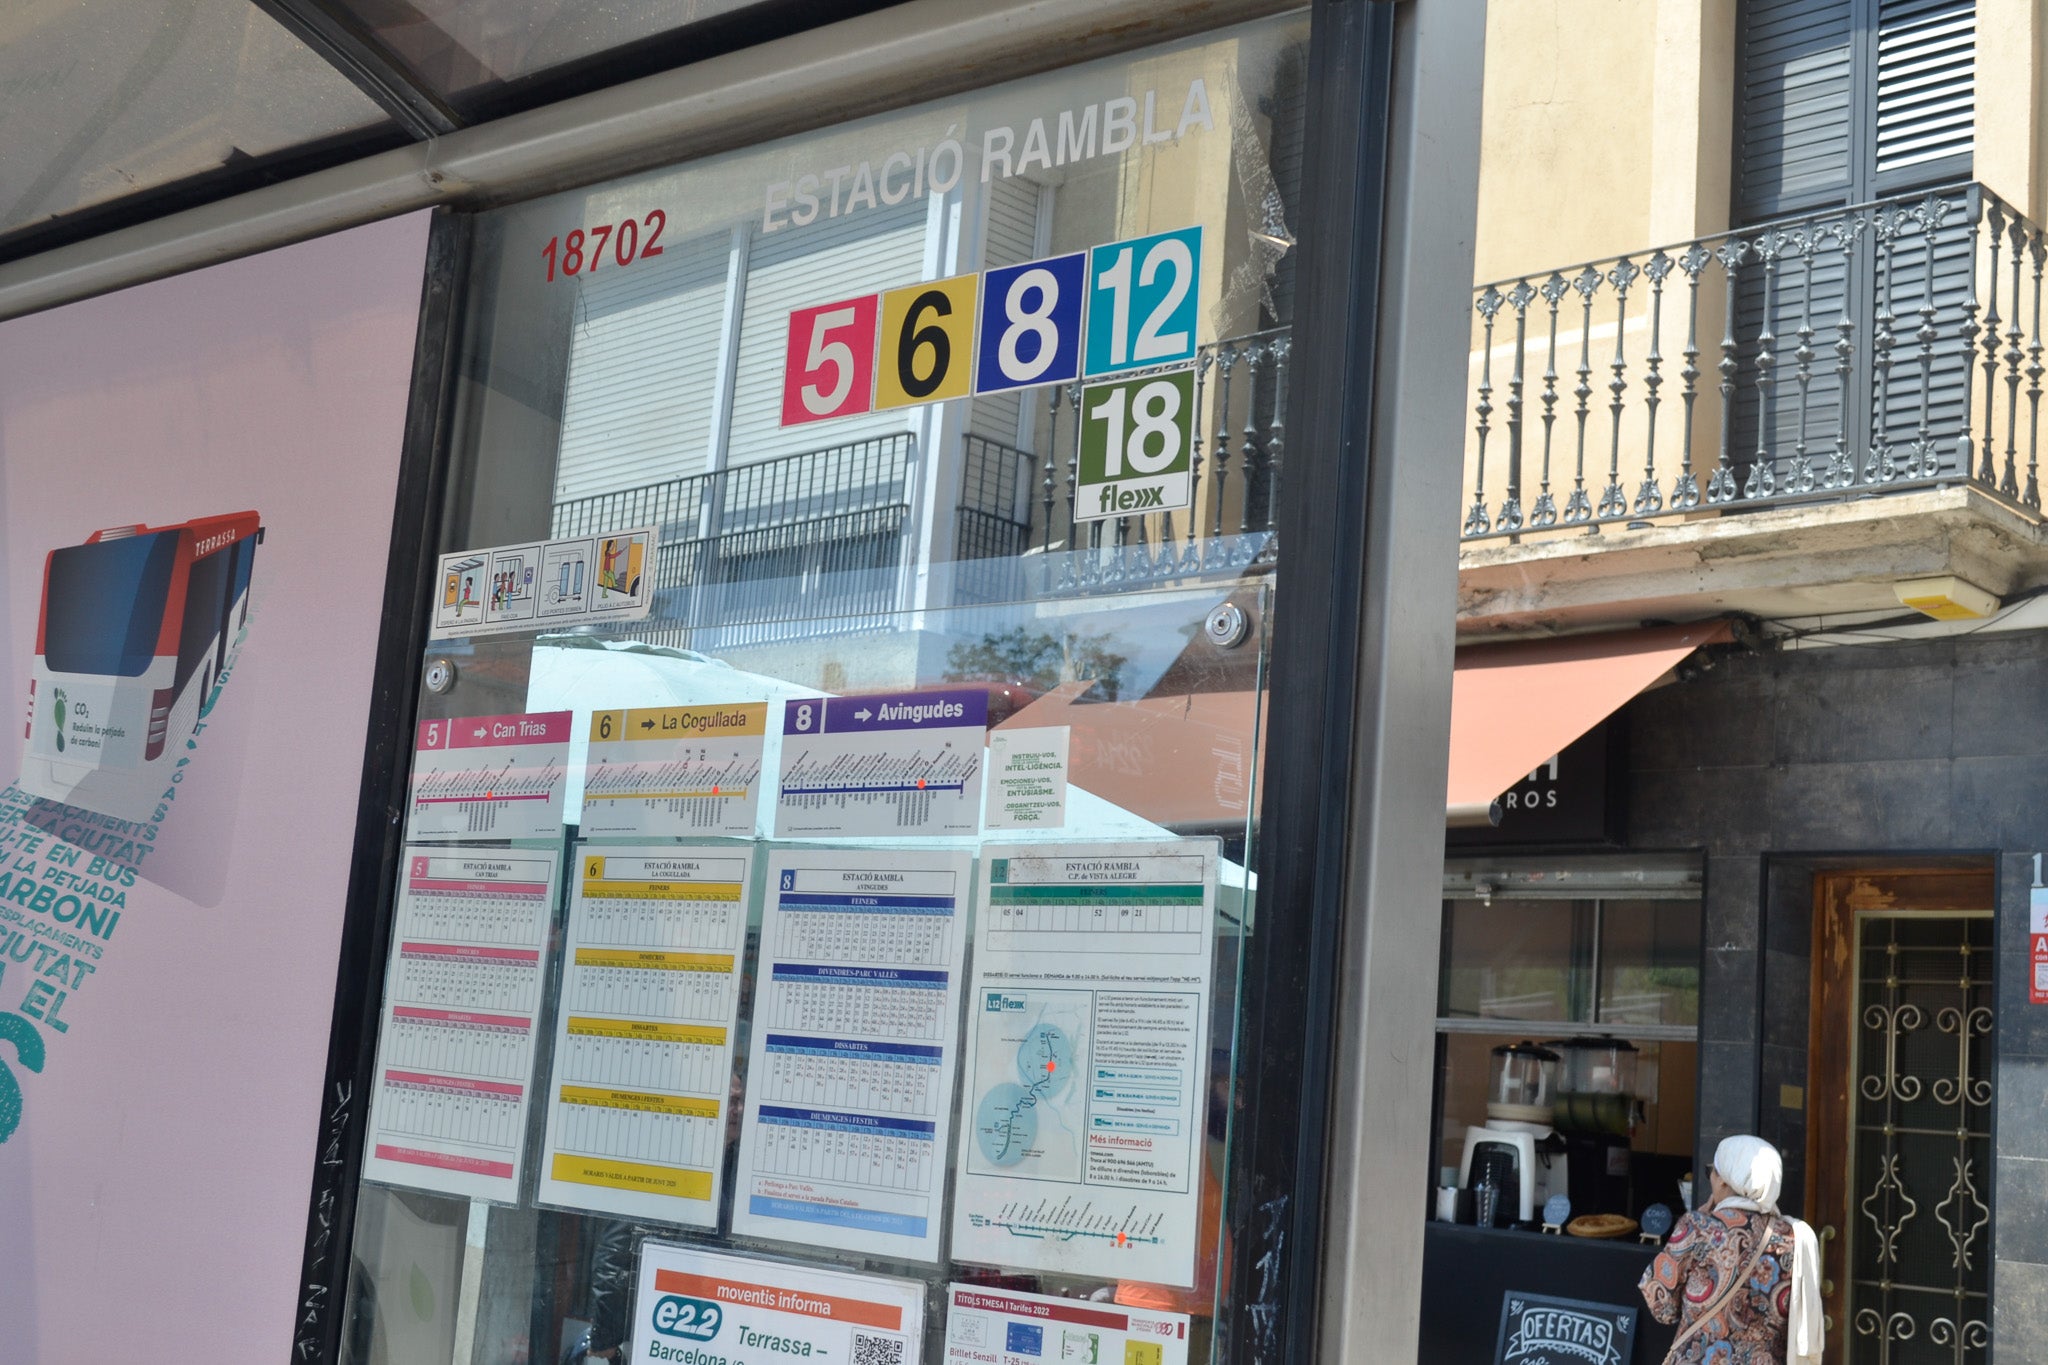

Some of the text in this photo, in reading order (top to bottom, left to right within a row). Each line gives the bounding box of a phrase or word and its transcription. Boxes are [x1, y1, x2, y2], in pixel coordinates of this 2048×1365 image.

[761, 78, 1214, 234] ESTACIÓ RAMBLA
[541, 209, 667, 282] 18702
[800, 238, 1195, 416] 5 6 8 12
[1090, 380, 1182, 478] 18
[195, 529, 236, 557] TERRASSA
[600, 710, 746, 739] 6 La Cogullada
[795, 700, 963, 731] 8 Avingudes
[426, 719, 546, 746] 5 Can Trias
[1494, 790, 1557, 809] ROS
[60, 823, 155, 866] CIUTAT
[46, 843, 82, 868] EN
[86, 854, 139, 888] BUS
[415, 861, 512, 876] 5 ESTACIÓ RAMBLA
[589, 860, 700, 877] 6 ESTACIÓ RAMBLA
[1066, 860, 1102, 871] ESTACIÓ
[1103, 862, 1140, 871] RAMBLA
[1109, 872, 1137, 880] ALEGRE
[13, 856, 126, 909] LA PETJADA
[782, 871, 904, 889] 8 ESTACIÓ RAMBLA
[856, 883, 888, 891] AVINGUDES
[851, 897, 878, 906] FEINERS
[20, 979, 70, 1034] EL
[834, 1041, 868, 1051] DISSABTES
[810, 1112, 879, 1126] DIUMENGES FESTIUS
[1090, 1134, 1152, 1148] Més informació
[717, 1283, 831, 1316] moventis informa
[981, 1298, 1004, 1309] TMESA
[1010, 1302, 1032, 1313] Tarifes
[1033, 1306, 1050, 1316] 2022
[738, 1325, 812, 1357] Terrassa
[1524, 1312, 1607, 1348] OFERTAS
[950, 1347, 997, 1364] Bitllet Senzill
